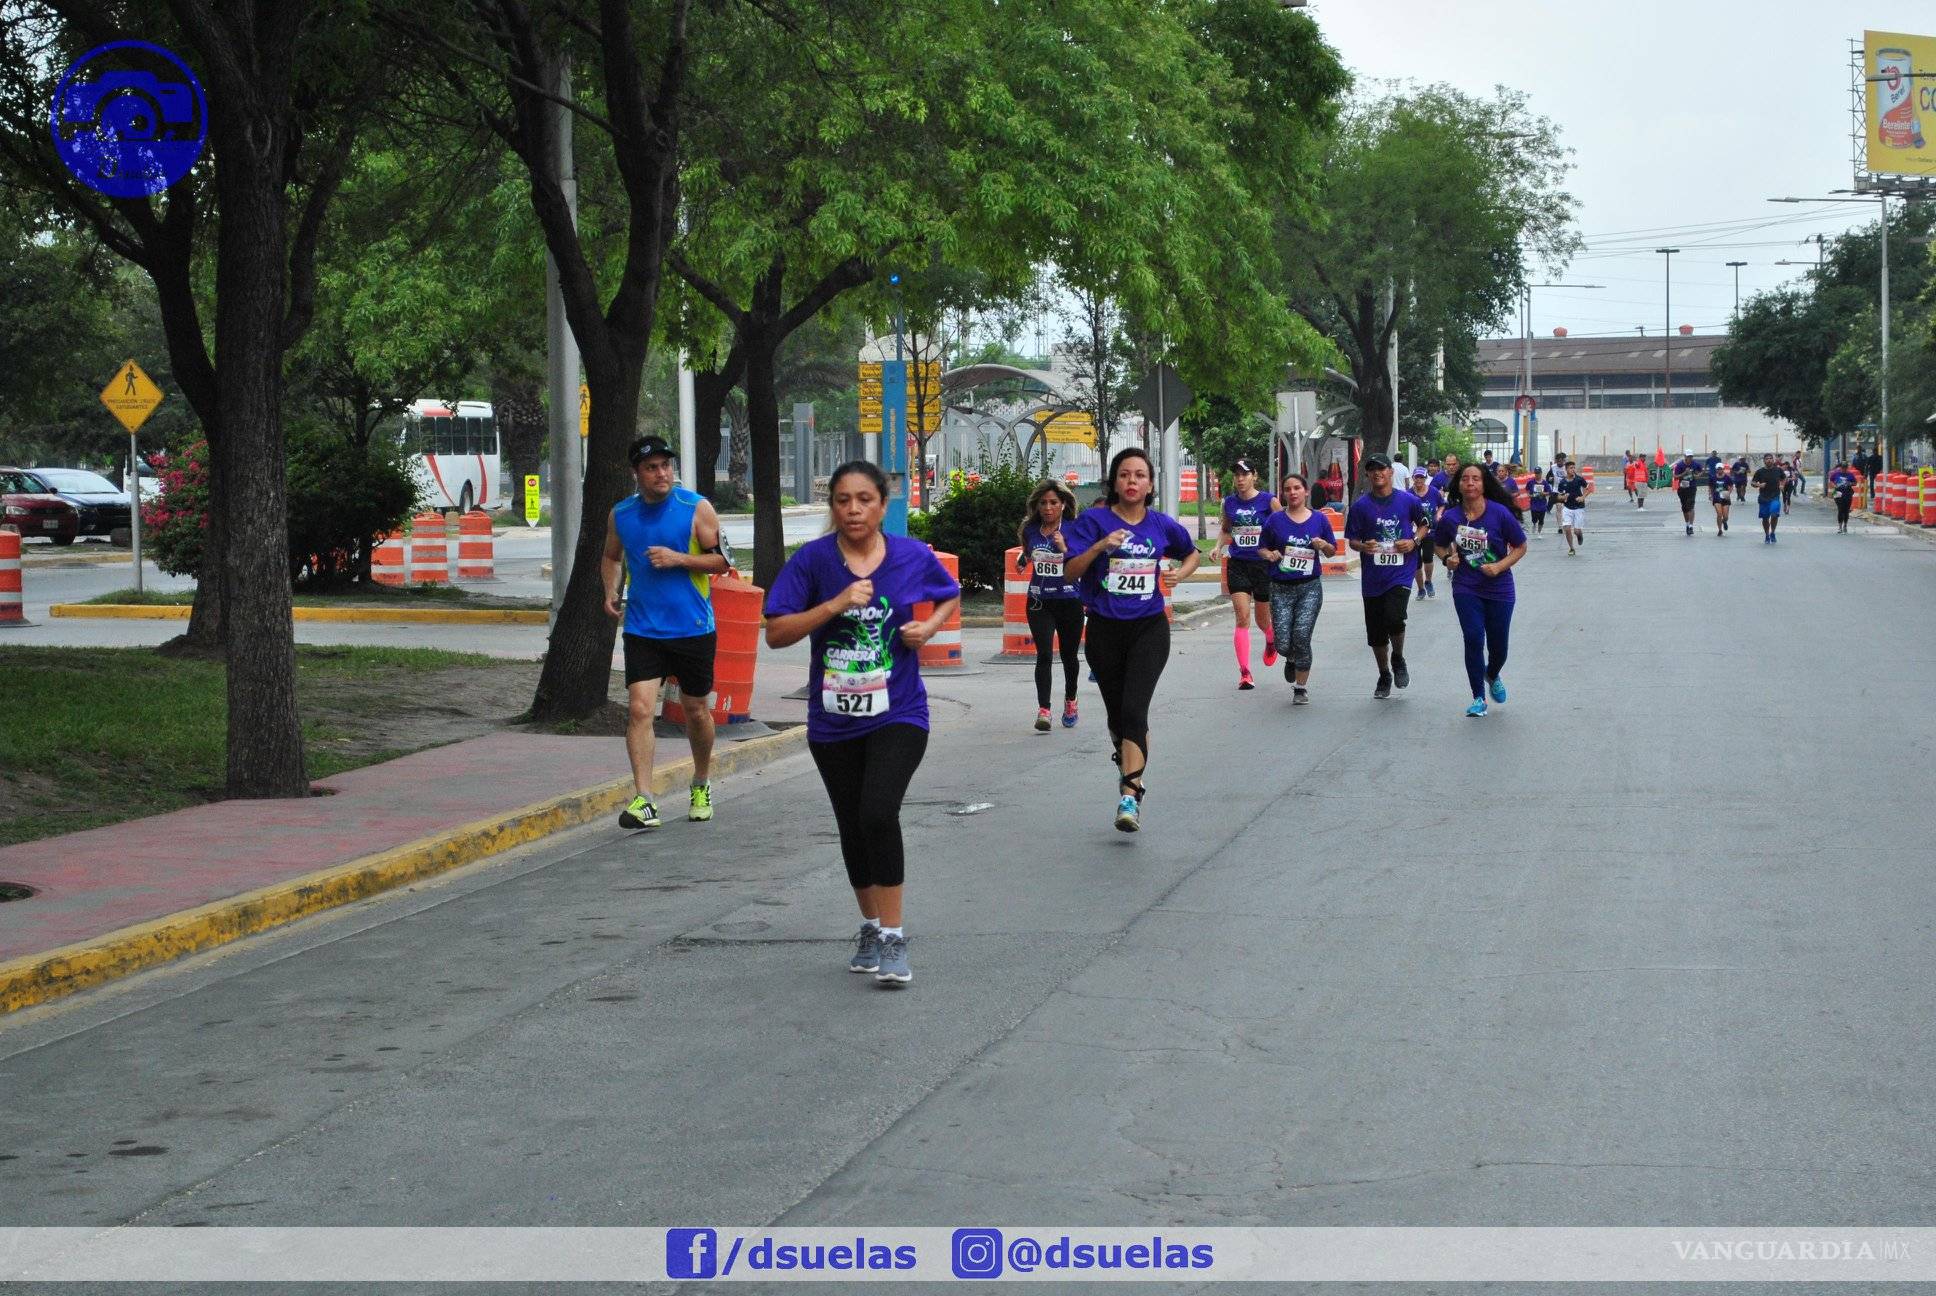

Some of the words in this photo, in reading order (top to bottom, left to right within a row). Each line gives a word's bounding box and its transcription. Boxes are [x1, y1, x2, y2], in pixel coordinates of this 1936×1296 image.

[1239, 535, 1257, 546] 609
[1289, 557, 1308, 569] 972
[1380, 554, 1398, 565] 970
[1037, 562, 1058, 575] 866
[1118, 575, 1146, 591] 244
[826, 648, 876, 662] CARRERA
[836, 693, 873, 713] 527
